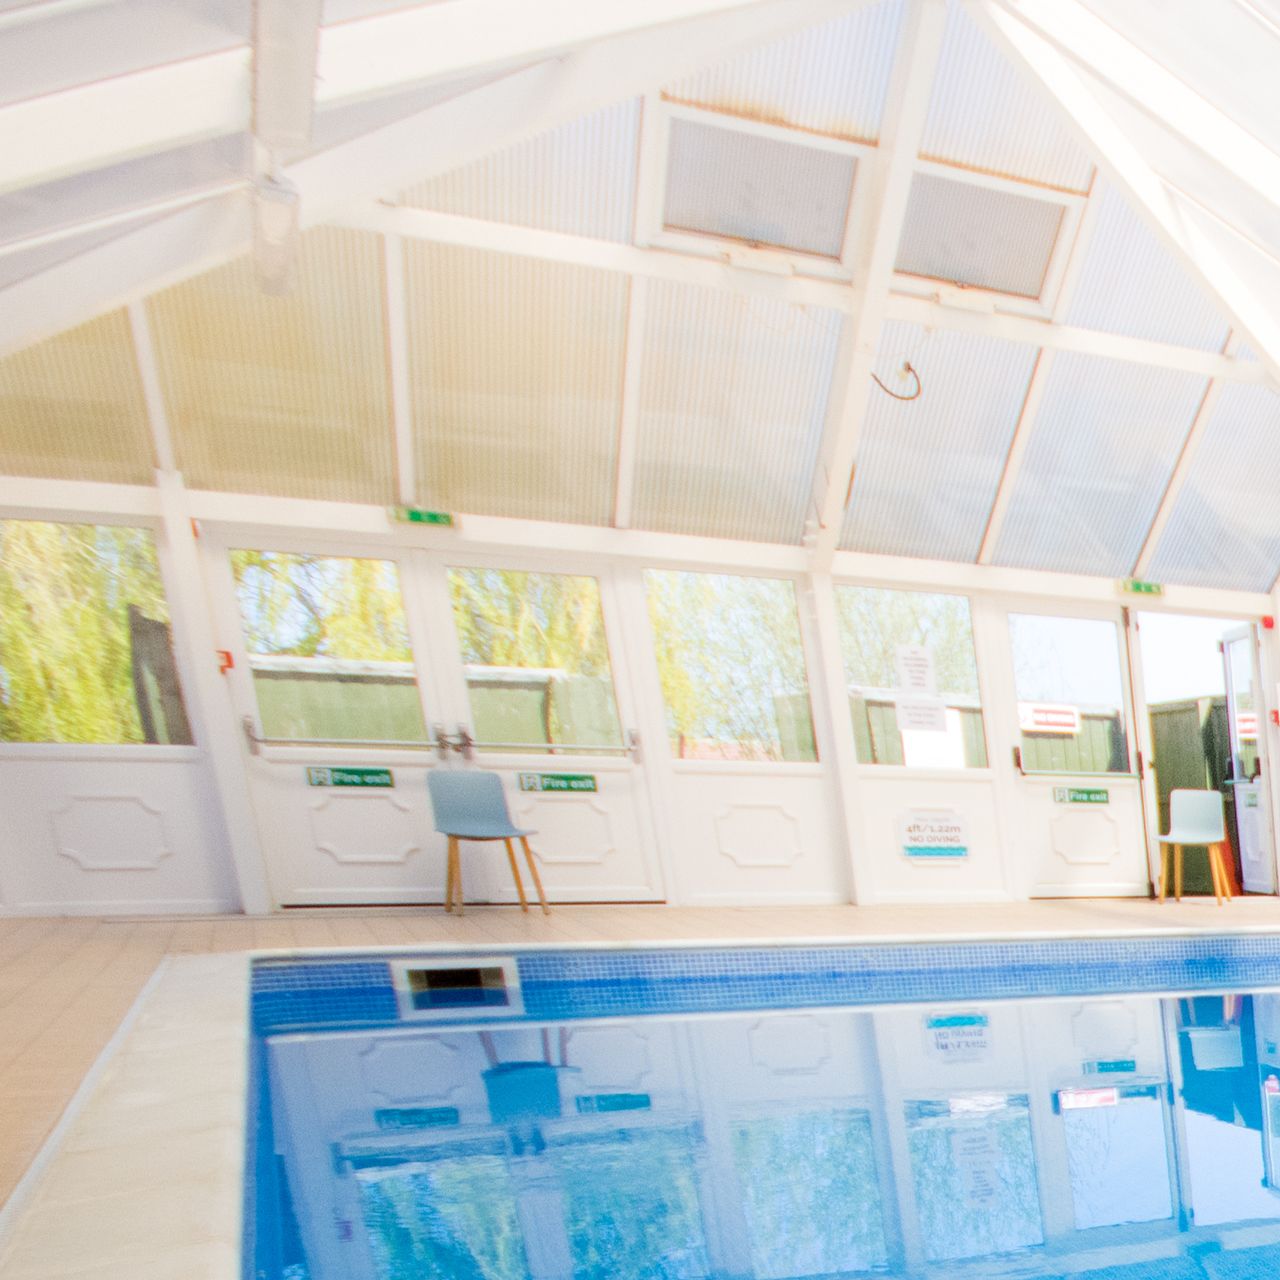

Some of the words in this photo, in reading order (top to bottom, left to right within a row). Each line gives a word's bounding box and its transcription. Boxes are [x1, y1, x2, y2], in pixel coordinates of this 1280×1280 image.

[334, 771, 361, 784] Fire
[363, 773, 391, 784] exit
[543, 777, 567, 789] Fire
[570, 779, 594, 789] exit
[1070, 791, 1087, 801] Fire
[909, 834, 924, 843] NO
[926, 834, 961, 843] DIVING
